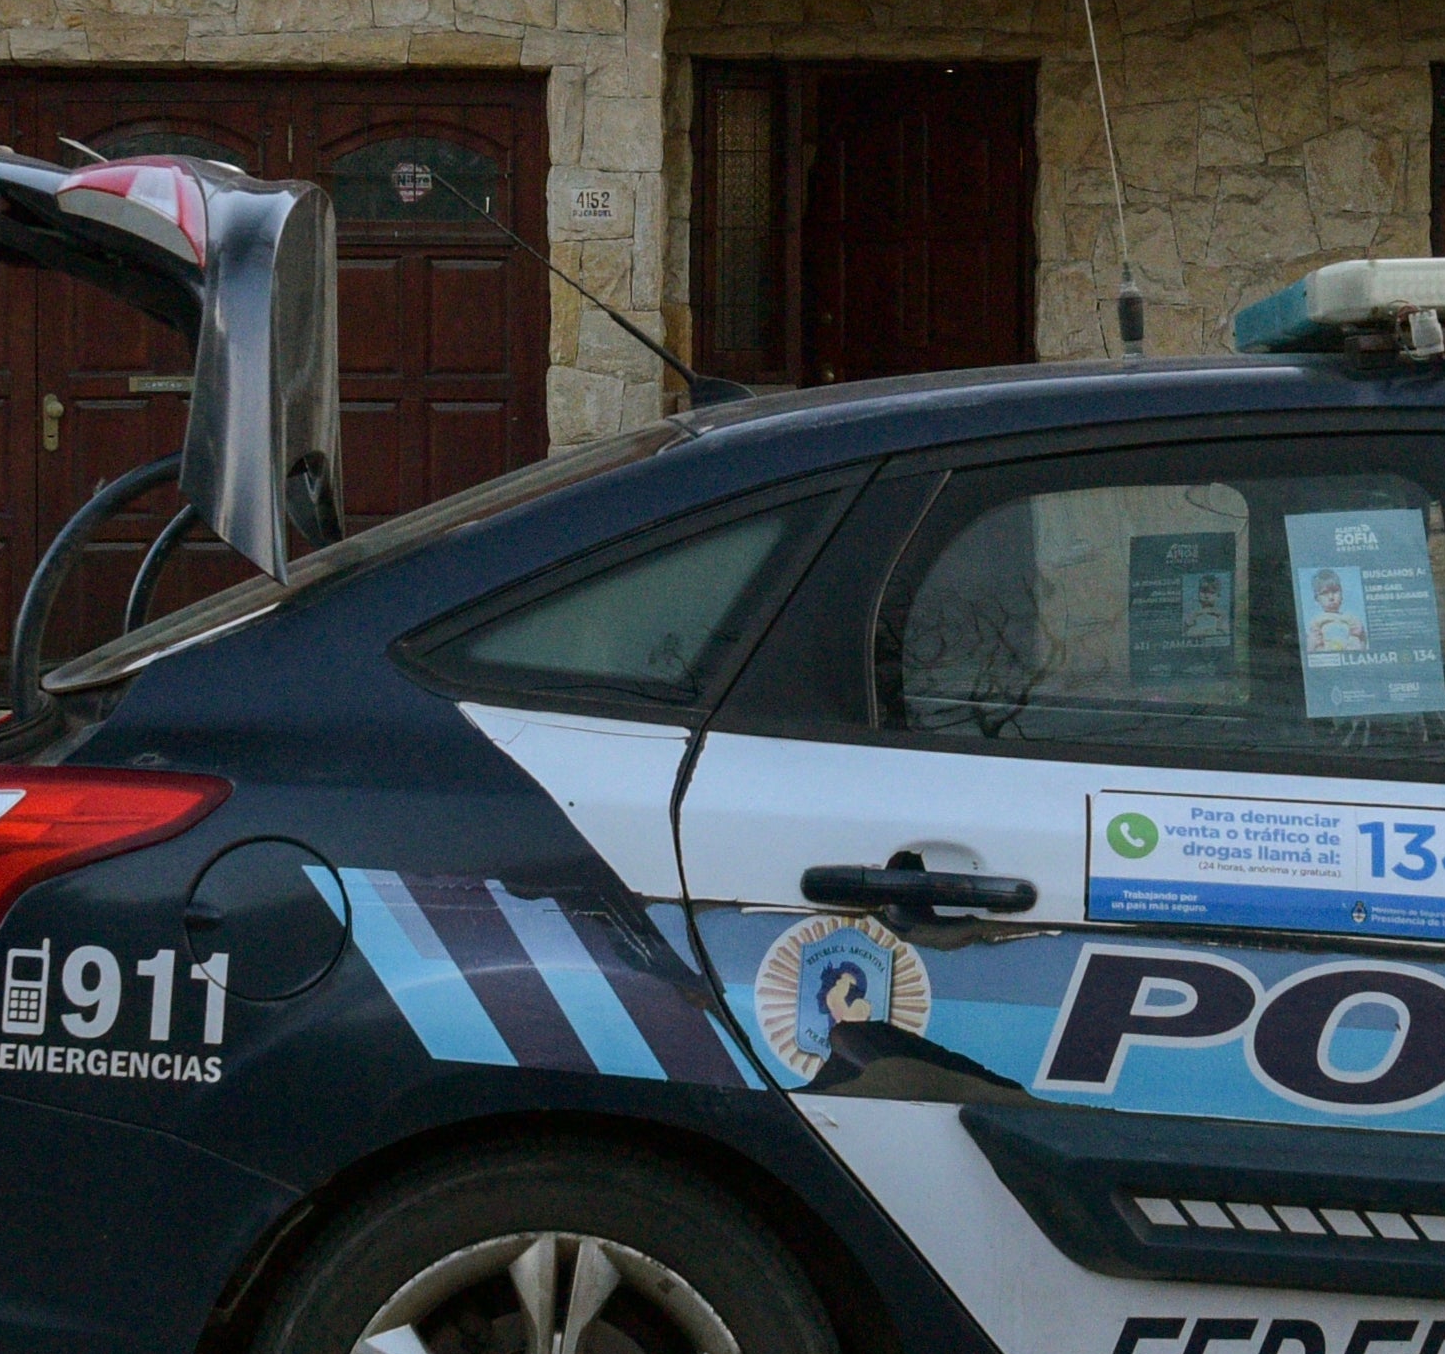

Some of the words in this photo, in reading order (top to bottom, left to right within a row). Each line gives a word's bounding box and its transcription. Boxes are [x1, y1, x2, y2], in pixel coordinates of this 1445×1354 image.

[576, 191, 610, 208] 4152
[1362, 568, 1414, 579] BUSCAMOS
[1341, 651, 1398, 666] LLAMAR
[1413, 649, 1436, 662] 134
[1191, 807, 1235, 822] Para
[1241, 809, 1340, 828] denunciar
[1164, 825, 1220, 839] venta
[1226, 829, 1238, 840] o
[1245, 826, 1310, 844] tráfico
[1316, 832, 1340, 846] de
[1183, 842, 1252, 861] drogas
[1258, 846, 1312, 863] llamá
[1317, 850, 1341, 865] al:
[1198, 861, 1214, 871] (24
[1217, 862, 1246, 873] horas,
[1248, 865, 1289, 875] anónima
[1300, 868, 1341, 878] gratuita)
[1122, 889, 1178, 901] Trabajando
[1180, 893, 1198, 903] por
[1111, 902, 1124, 910] un
[1172, 904, 1208, 914] seguro.
[1371, 914, 1425, 926] Presidencia
[1428, 918, 1439, 927] de
[61, 945, 229, 1044] 911
